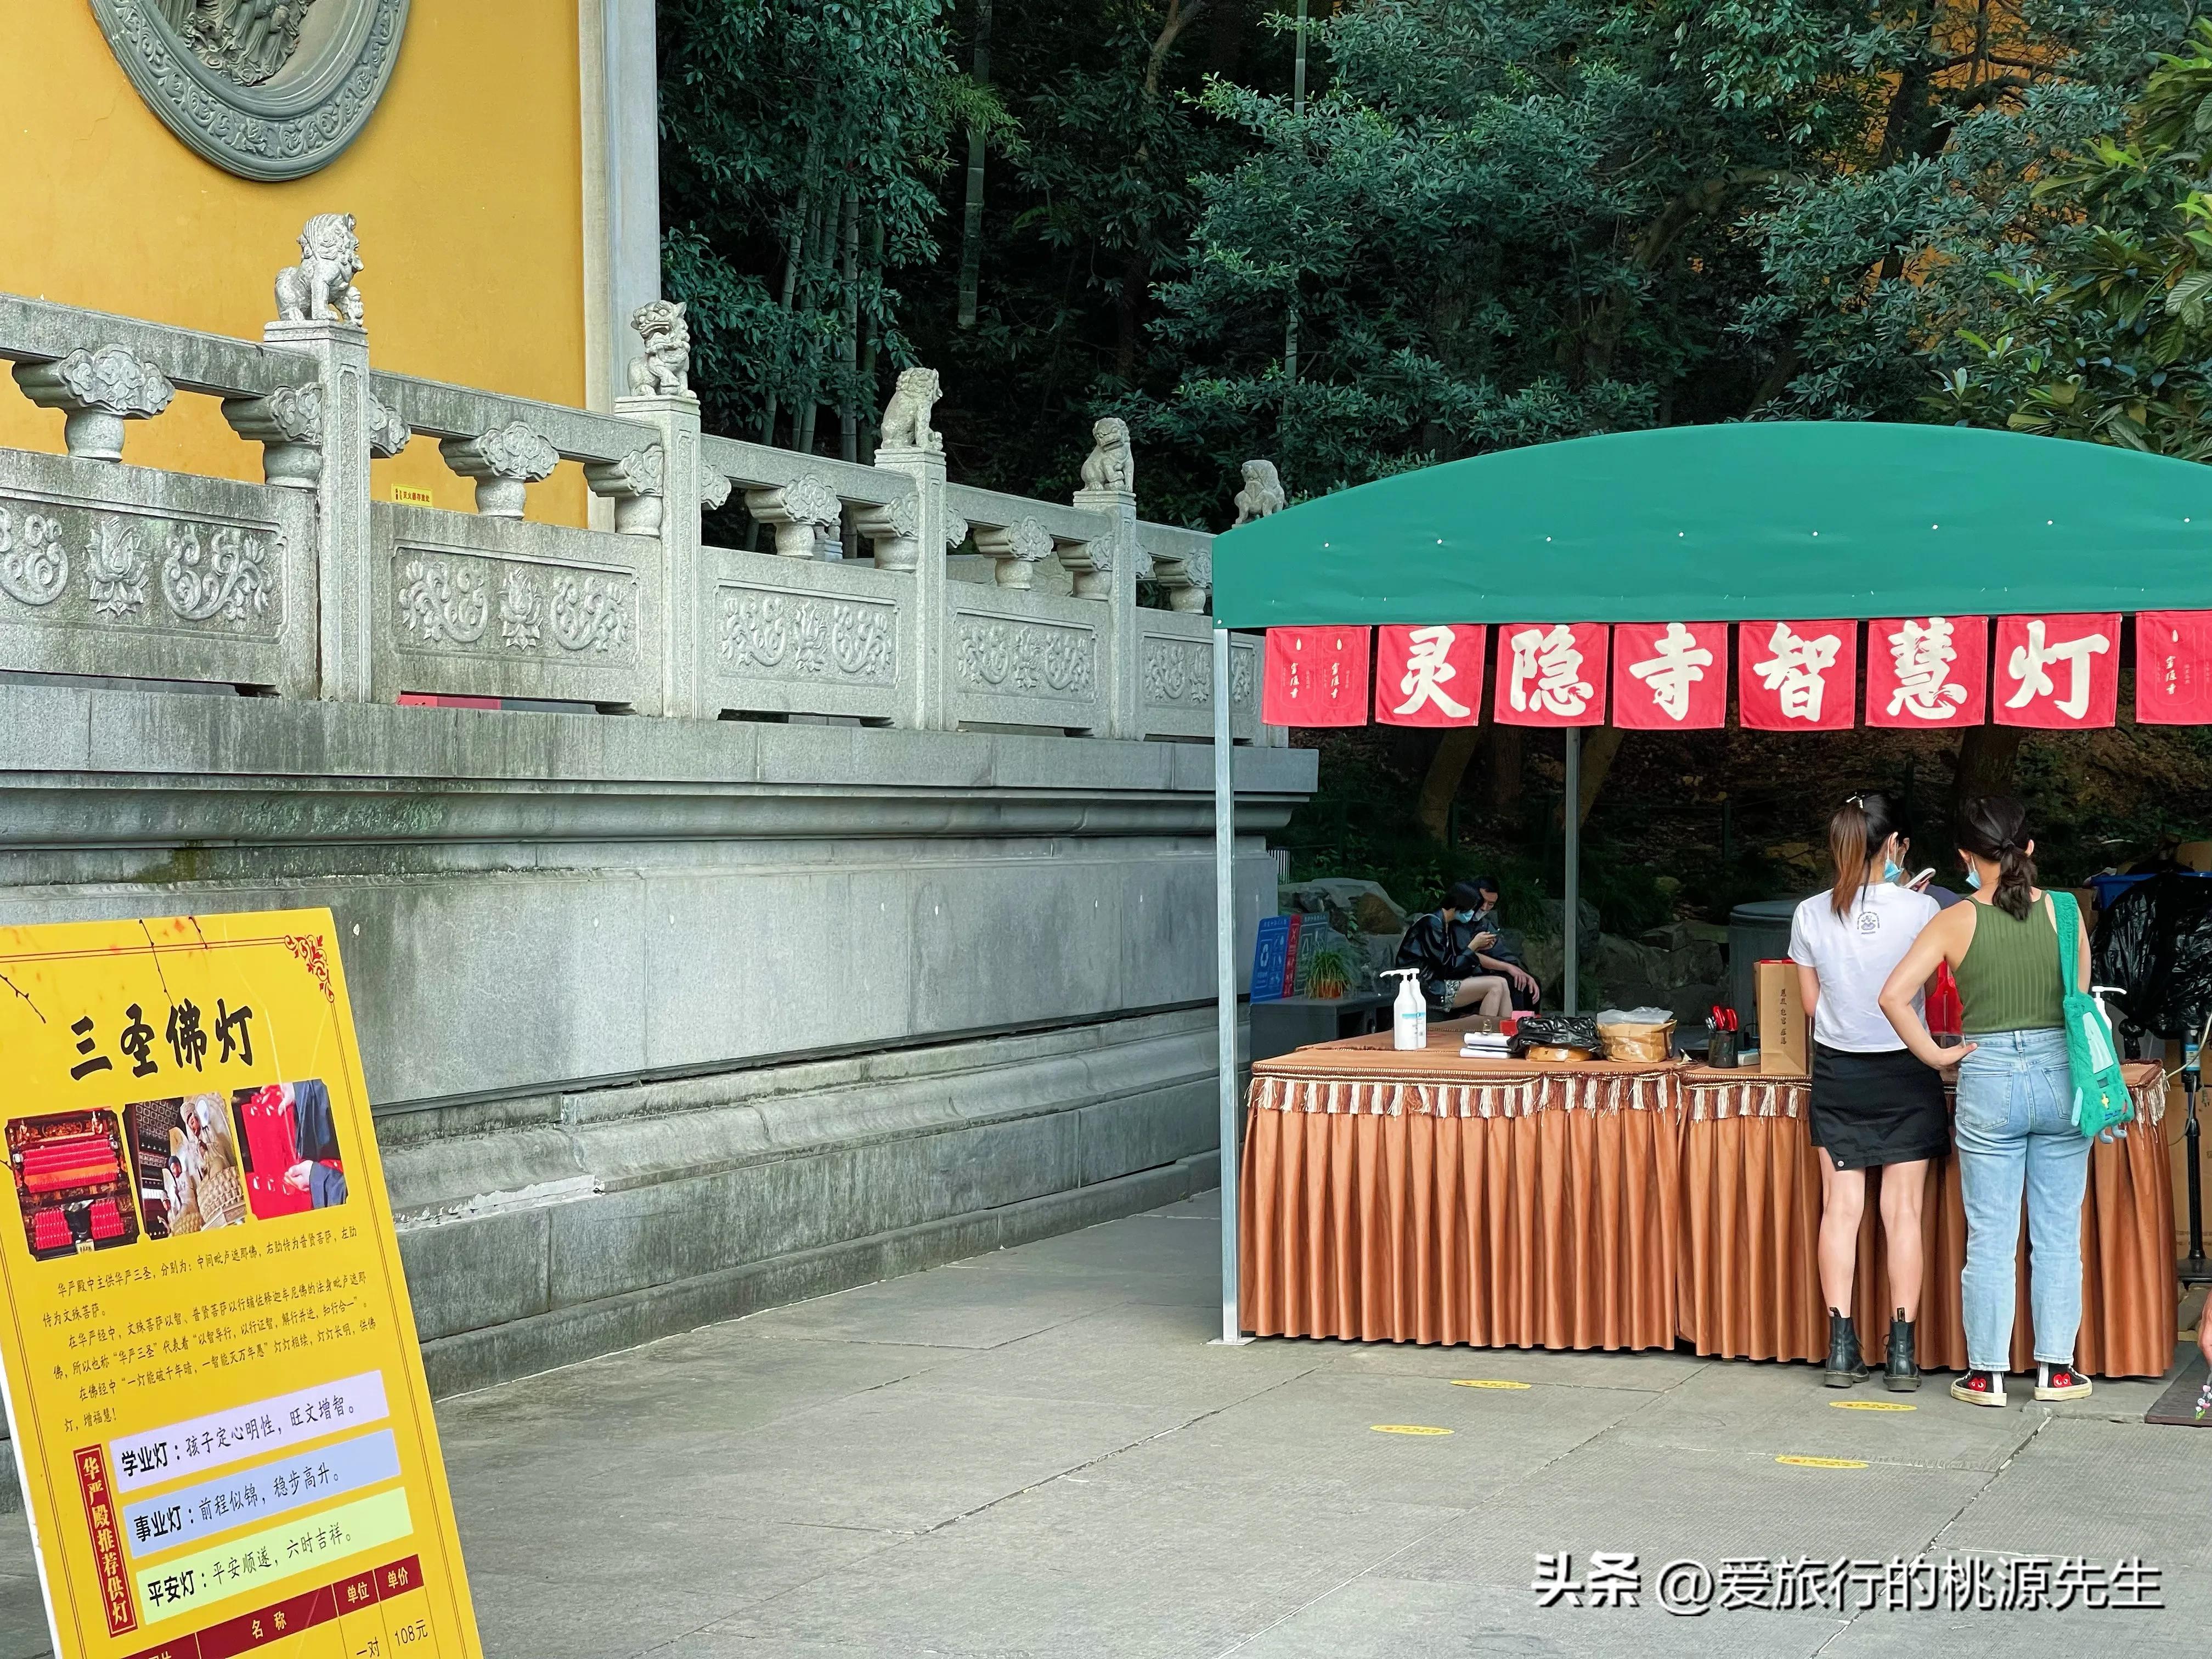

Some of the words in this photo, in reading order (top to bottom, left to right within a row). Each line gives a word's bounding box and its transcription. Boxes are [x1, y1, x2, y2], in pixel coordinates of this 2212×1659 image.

[1393, 617, 2111, 722] 灵隐寺智慧灯
[70, 998, 253, 1081] 三圣佛灯
[83, 1457, 128, 1626] 华严殿推荐供灯
[387, 1566, 409, 1589] 单价
[347, 1581, 370, 1604] 单位
[394, 1619, 428, 1646] 108元
[356, 1636, 380, 1658] 一对
